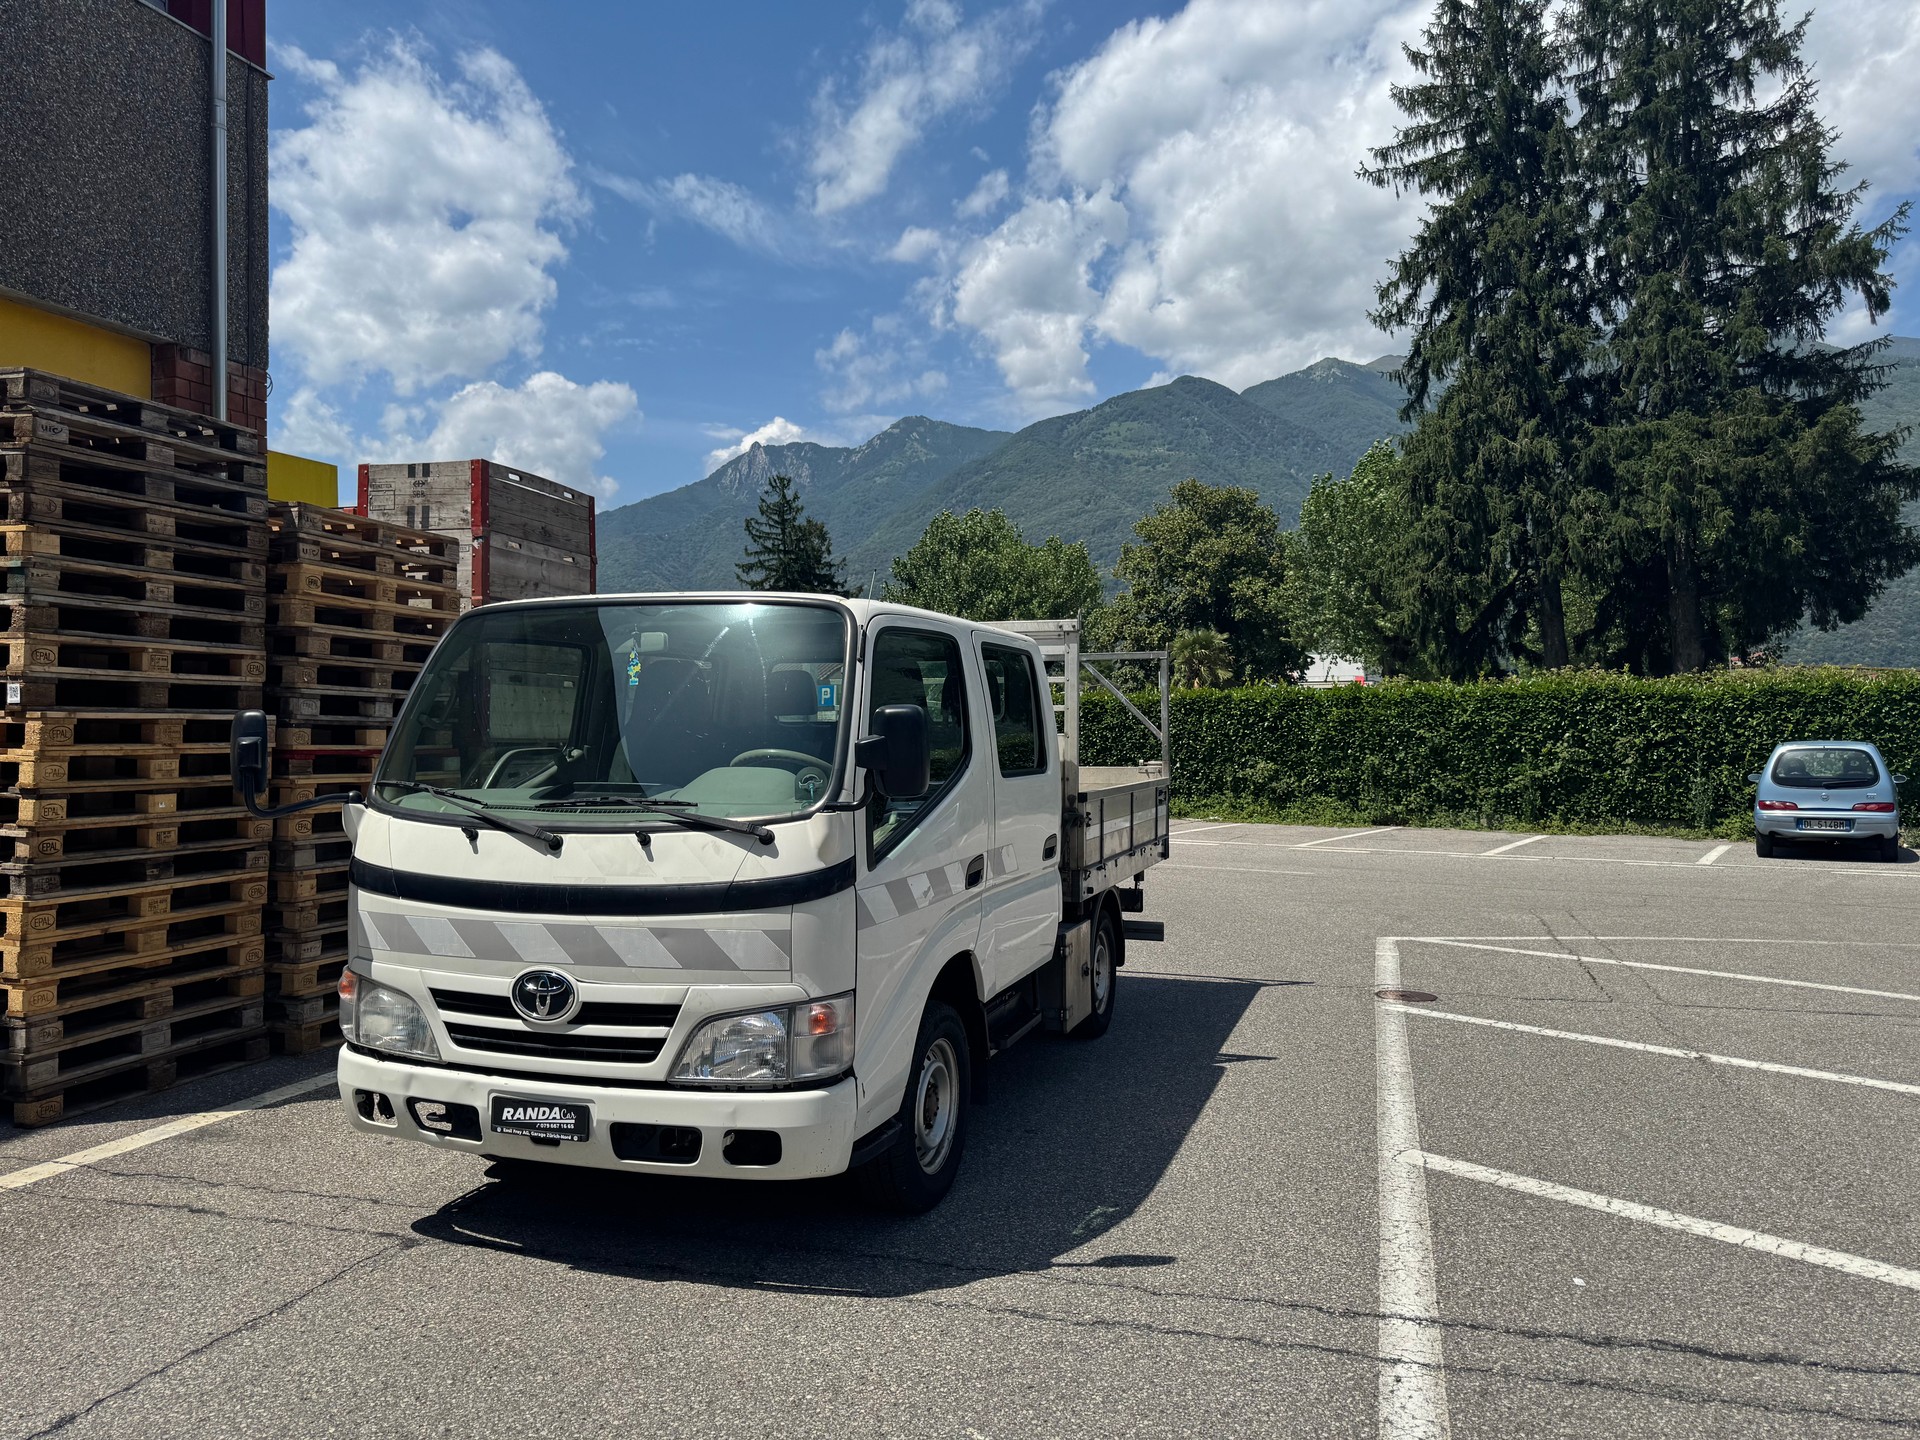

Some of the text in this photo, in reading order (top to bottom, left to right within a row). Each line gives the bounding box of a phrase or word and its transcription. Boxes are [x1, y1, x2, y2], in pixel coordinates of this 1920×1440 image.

[36, 651, 51, 662] EPAL
[821, 687, 831, 705] P
[52, 729, 69, 739] EPAL
[43, 806, 60, 817] EPAL
[34, 917, 51, 928] EPAL
[502, 1107, 576, 1120] RANDA Car
